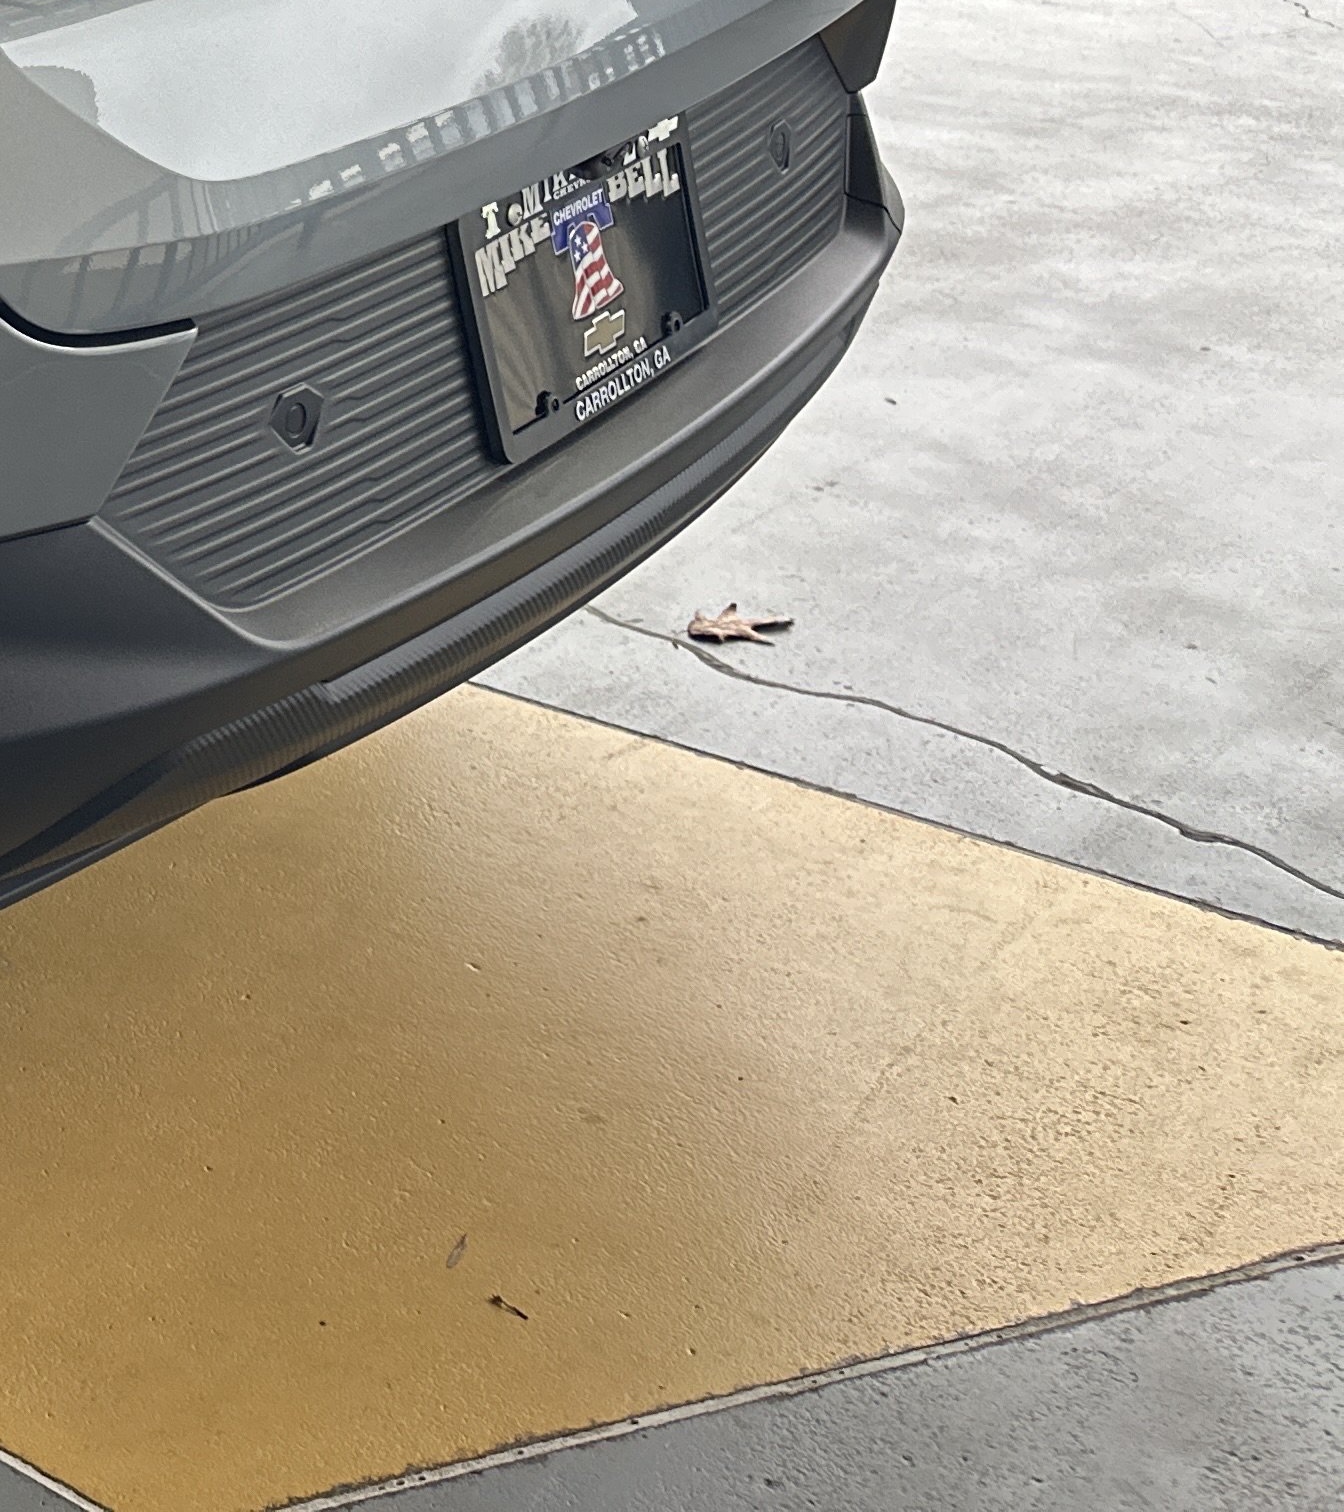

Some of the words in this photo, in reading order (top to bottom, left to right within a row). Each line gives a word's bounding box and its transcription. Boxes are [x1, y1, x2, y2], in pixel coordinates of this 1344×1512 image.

[474, 212, 552, 297] MIKE
[606, 148, 681, 203] BELL
[522, 170, 576, 220] MIK
[553, 187, 604, 226] CHEVROLET
[575, 346, 634, 391] CARROLLTON,
[633, 336, 648, 354] GA
[575, 357, 655, 421] CARROLLTON,
[653, 345, 672, 370] GA
